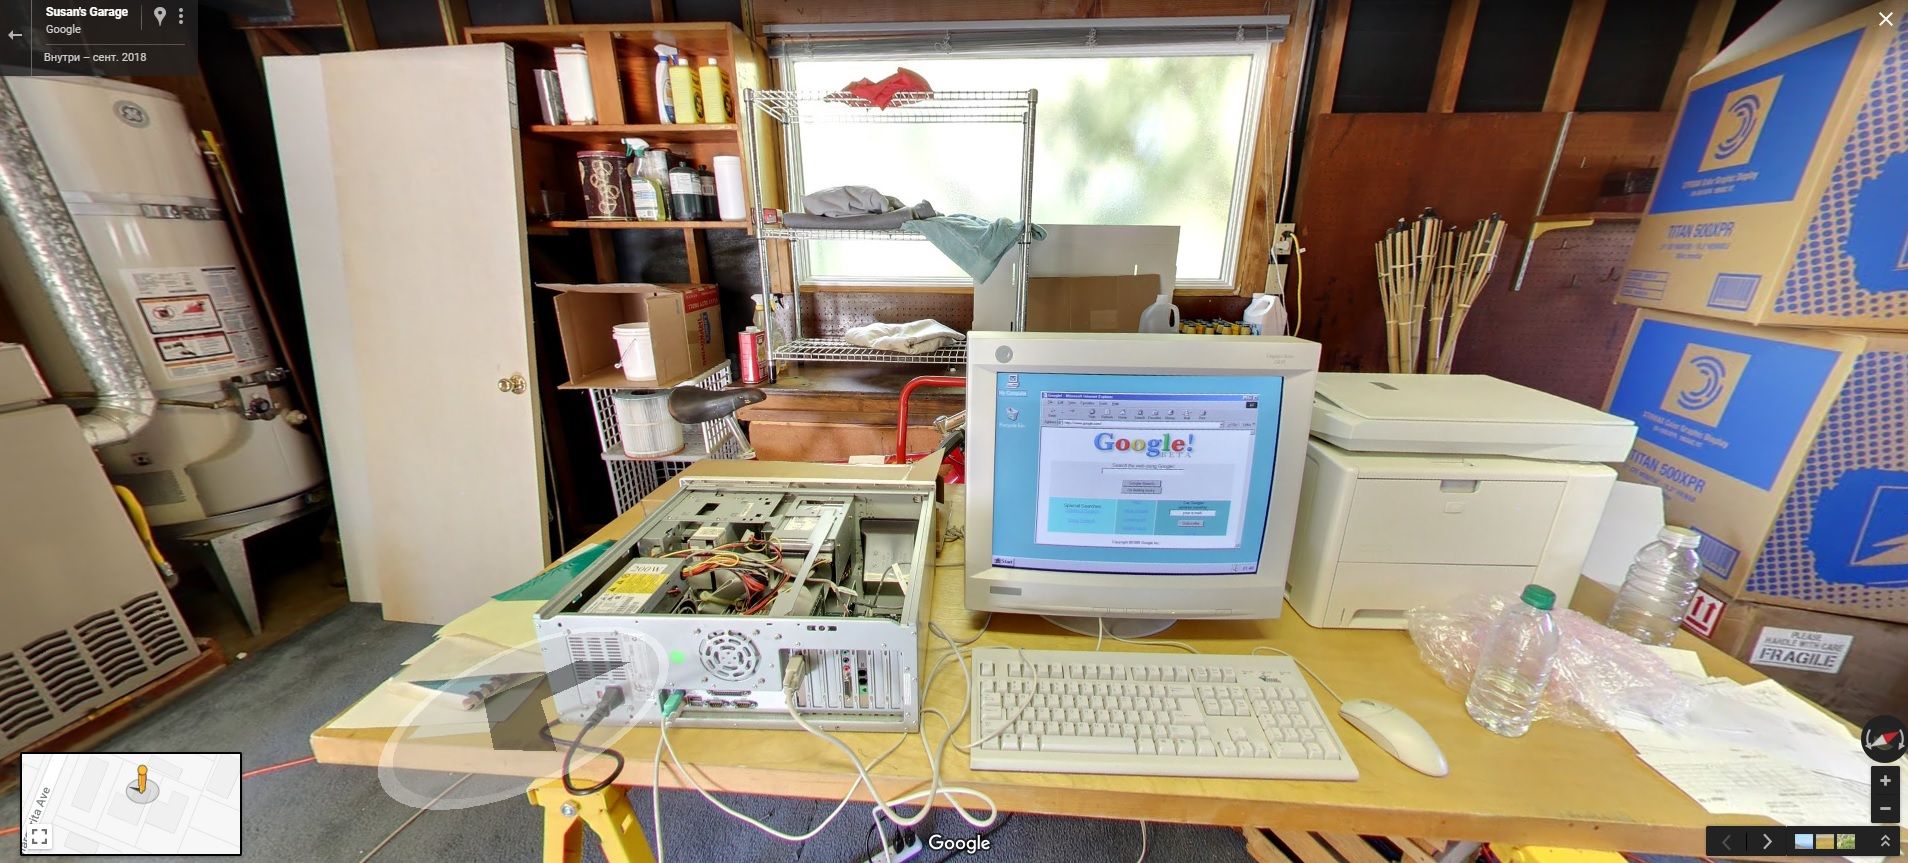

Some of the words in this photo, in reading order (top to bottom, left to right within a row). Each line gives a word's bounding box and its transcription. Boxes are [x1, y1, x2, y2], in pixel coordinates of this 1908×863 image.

[1667, 224, 1693, 238] TITAN
[1093, 432, 1195, 458] Google!
[1631, 449, 1660, 472] TITAN
[1659, 463, 1706, 493] 500XPR
[1763, 637, 1798, 647] HANDLE
[1799, 641, 1820, 649] WITH
[1820, 643, 1845, 652] CARE
[1791, 632, 1822, 641] PLEASE
[1759, 648, 1838, 667] FRAGILE
